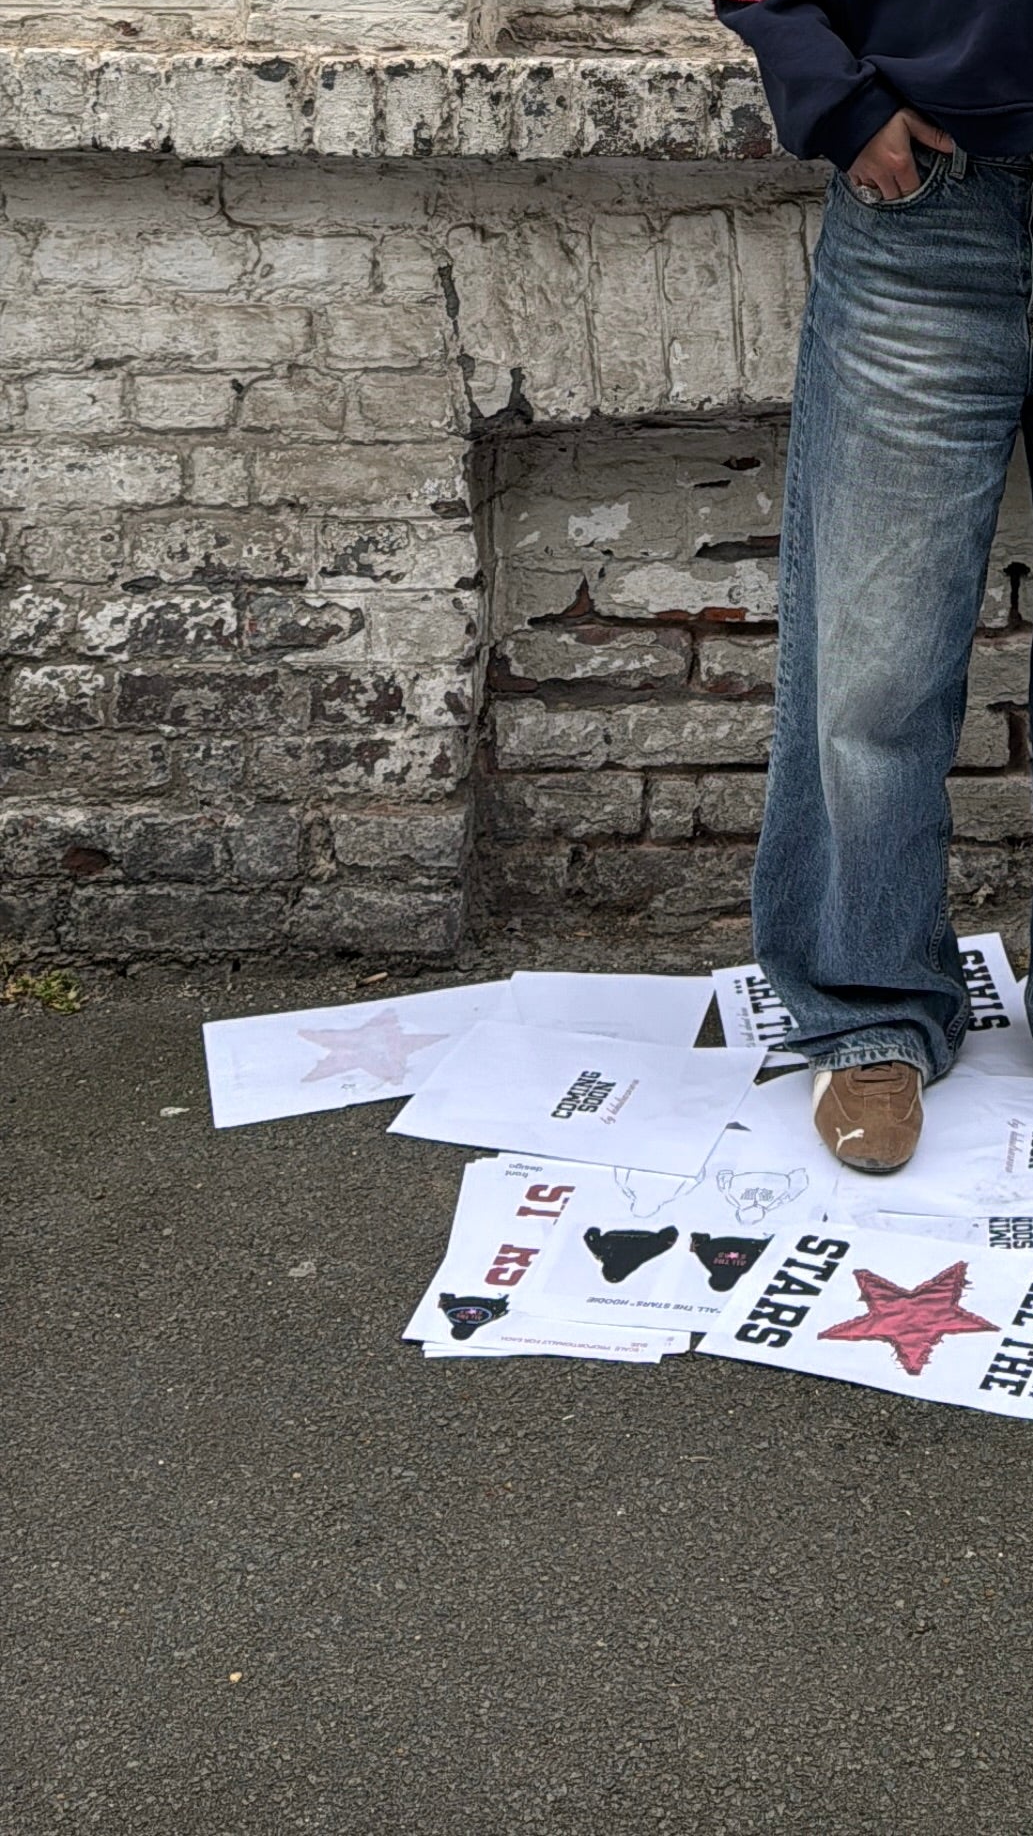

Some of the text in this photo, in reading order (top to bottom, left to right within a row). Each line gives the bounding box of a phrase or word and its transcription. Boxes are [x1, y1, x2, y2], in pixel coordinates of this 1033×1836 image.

[550, 1070, 602, 1119] COMING
[577, 1080, 617, 1113] SOON
[586, 1296, 629, 1306] HOODIE
[672, 1304, 694, 1312] THE
[734, 1234, 850, 1349] STARS
